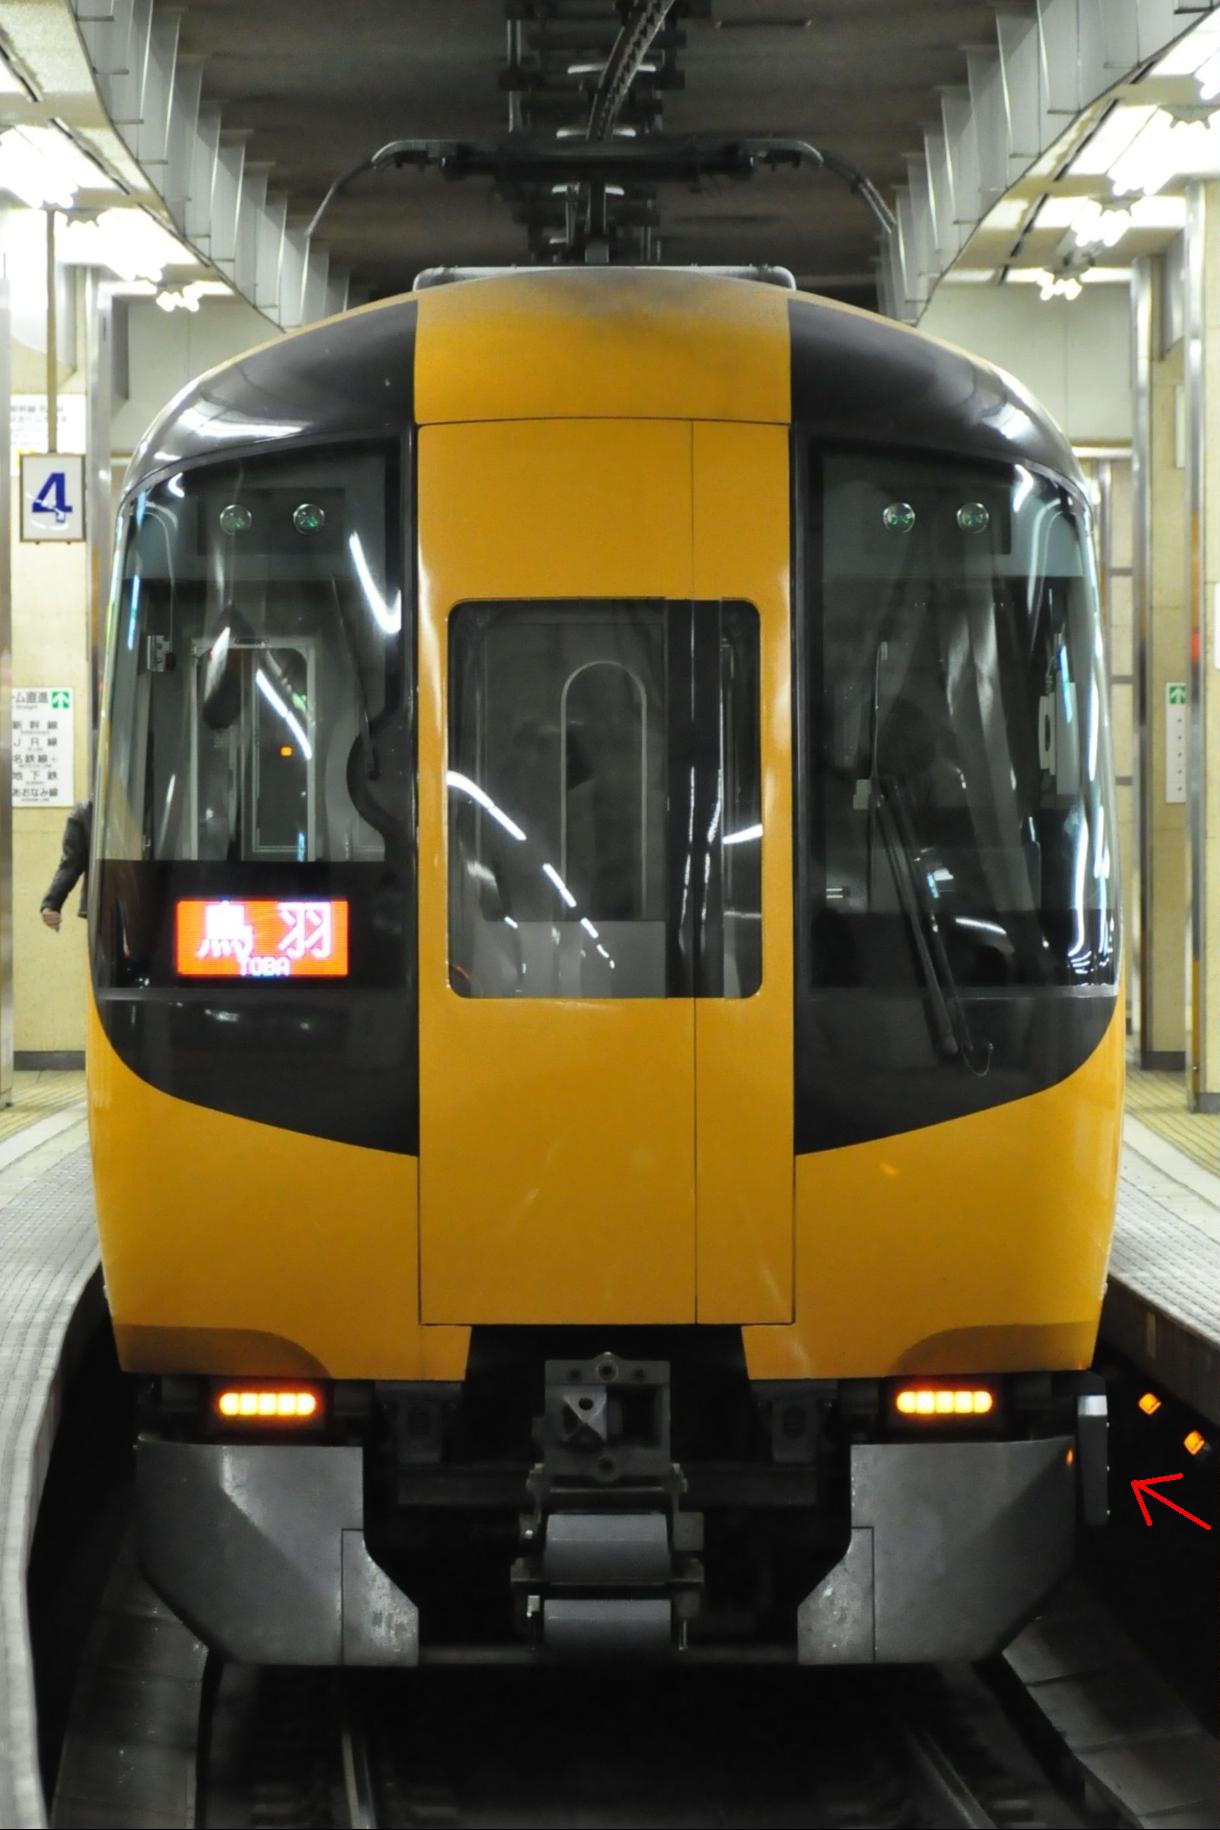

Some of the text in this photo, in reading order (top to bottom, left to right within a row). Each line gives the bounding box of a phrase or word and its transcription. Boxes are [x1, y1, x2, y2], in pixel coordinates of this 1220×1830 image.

[32, 472, 73, 523] 4
[196, 900, 332, 959] 鳥羽
[239, 956, 291, 977] TOBA
